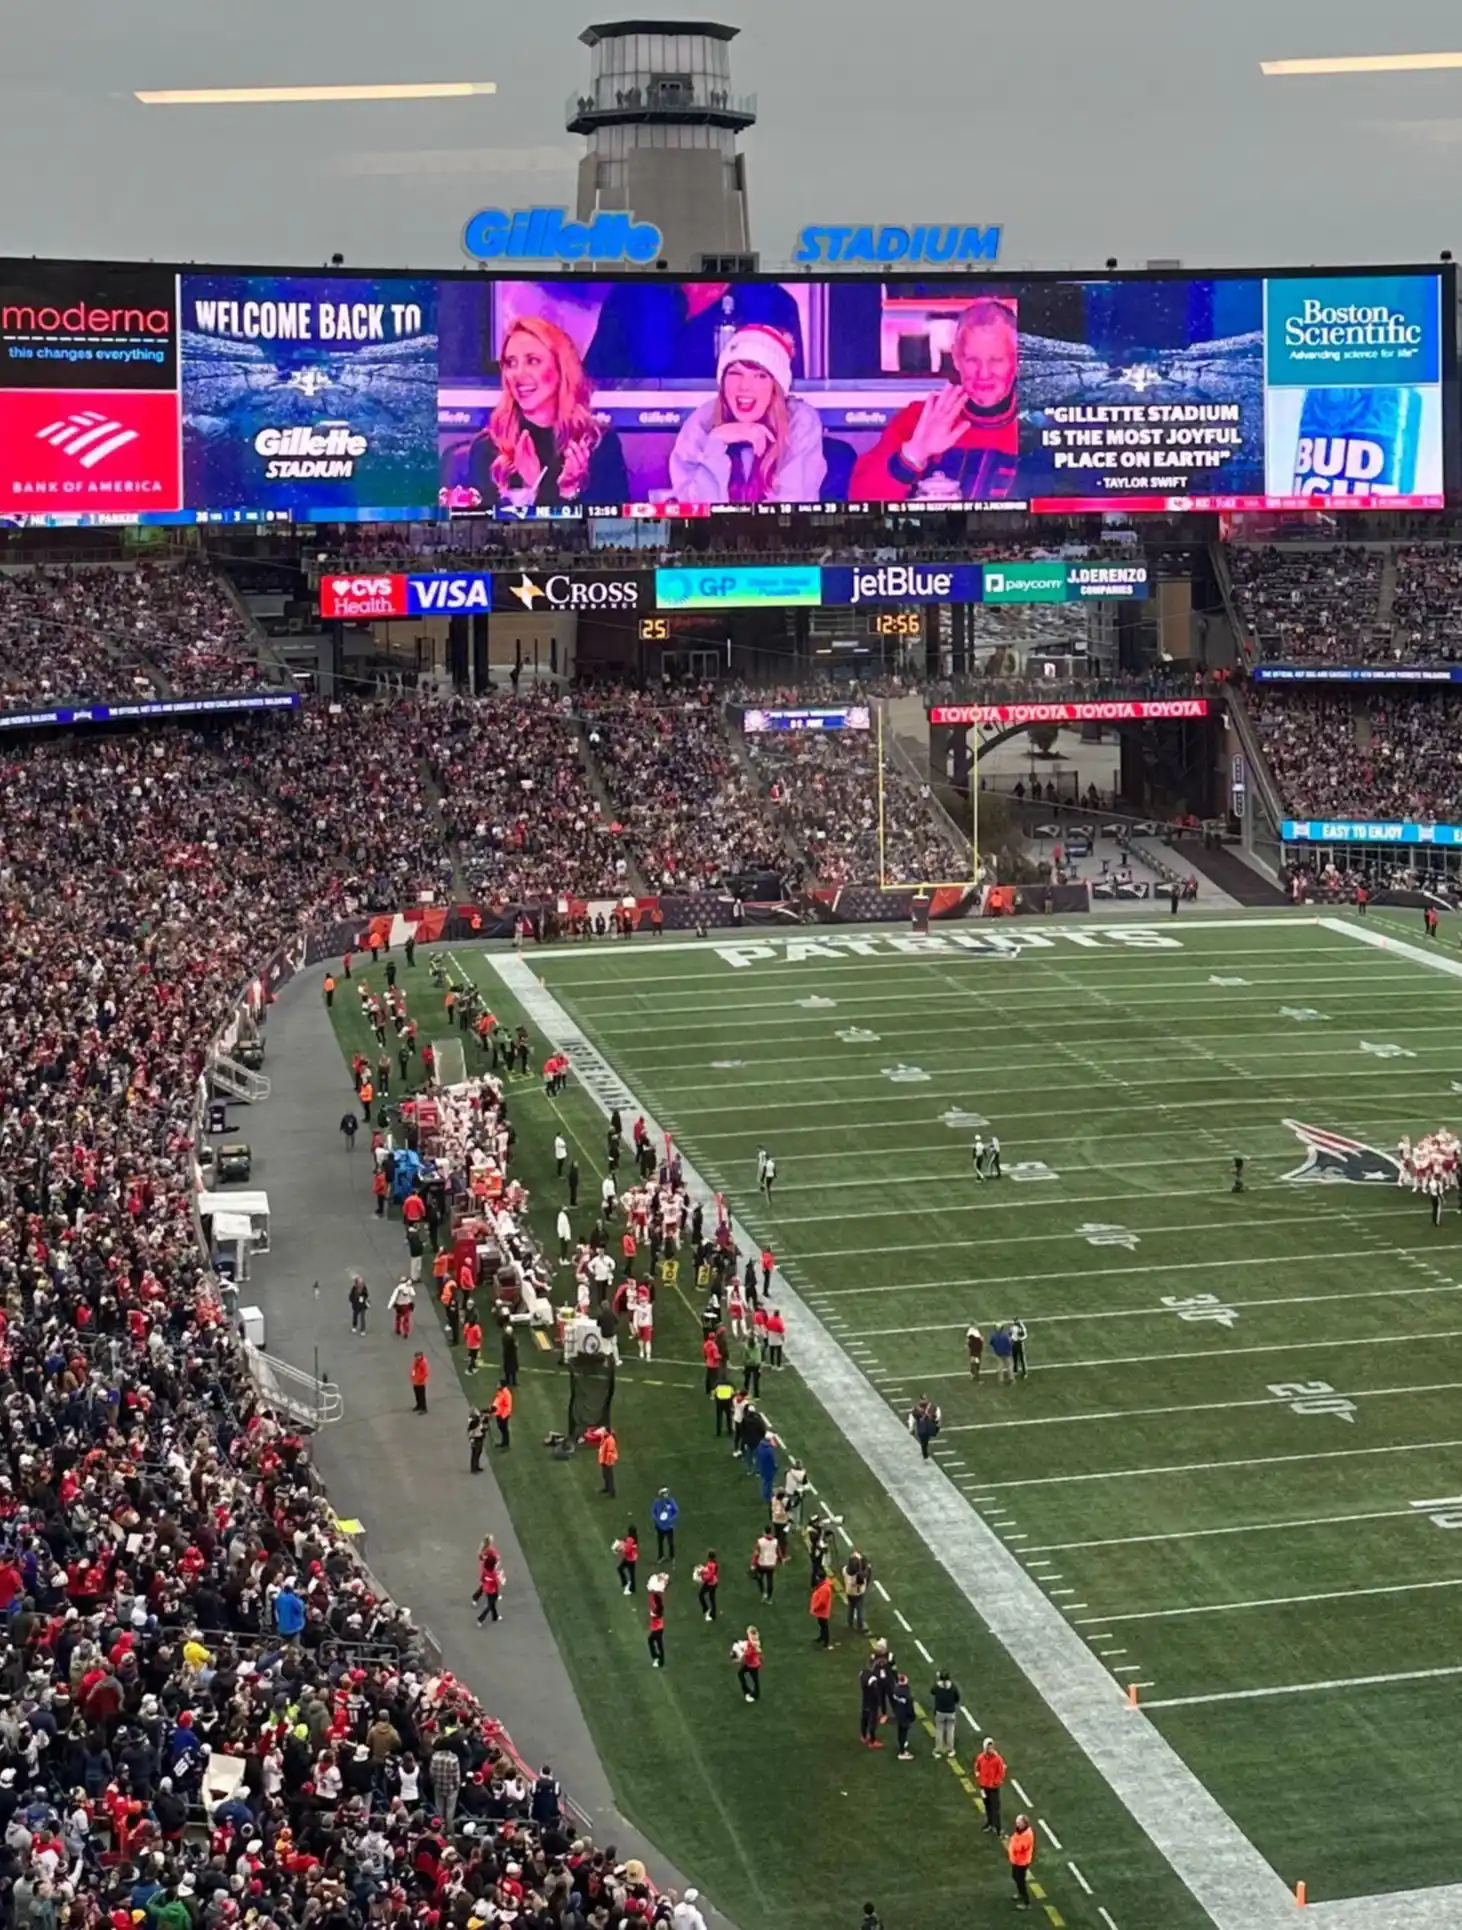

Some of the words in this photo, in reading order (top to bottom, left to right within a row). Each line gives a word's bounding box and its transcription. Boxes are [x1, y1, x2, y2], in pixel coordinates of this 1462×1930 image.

[463, 207, 662, 262] Gillette
[795, 226, 1001, 262] STADIUM
[3, 301, 169, 333] moderna
[195, 301, 312, 339] WELCOME
[319, 303, 384, 340] BACK
[391, 304, 422, 336] TO
[1303, 299, 1389, 324] Boston
[1285, 314, 1421, 346] Scientific
[36, 347, 93, 361] changes
[96, 348, 164, 362] everything
[1148, 405, 1239, 421] STADIUM
[255, 426, 367, 456] Gillette
[1042, 430, 1061, 446] IS
[1064, 430, 1103, 446] THE
[1107, 429, 1163, 445] MOST
[1165, 428, 1242, 444] JOYFUL
[1055, 452, 1118, 468] PLACE
[1120, 451, 1150, 468] ON
[1296, 437, 1385, 479] BUD
[265, 460, 353, 478] STADIUM
[12, 481, 58, 493] BANK
[63, 481, 82, 493] OF
[88, 481, 162, 493] AMERICA
[1103, 477, 1149, 488] TAYLOR
[1150, 476, 1188, 488] SWIFT
[587, 505, 618, 516] 12:56
[352, 579, 392, 596] CVS
[409, 580, 488, 608] VISA
[642, 619, 667, 639] 25
[876, 614, 920, 634] 12:56
[940, 707, 1000, 721] TOYOTA
[1007, 705, 1068, 719] TOYOTA
[1075, 703, 1135, 718] TOYOTA
[1142, 702, 1201, 716] TOYOTA
[1323, 823, 1350, 840] EASY
[1353, 823, 1366, 840] TO
[1369, 824, 1402, 841] ENJOY
[715, 930, 1184, 968] PATRIOTS
[1265, 1380, 1358, 1415] 20
